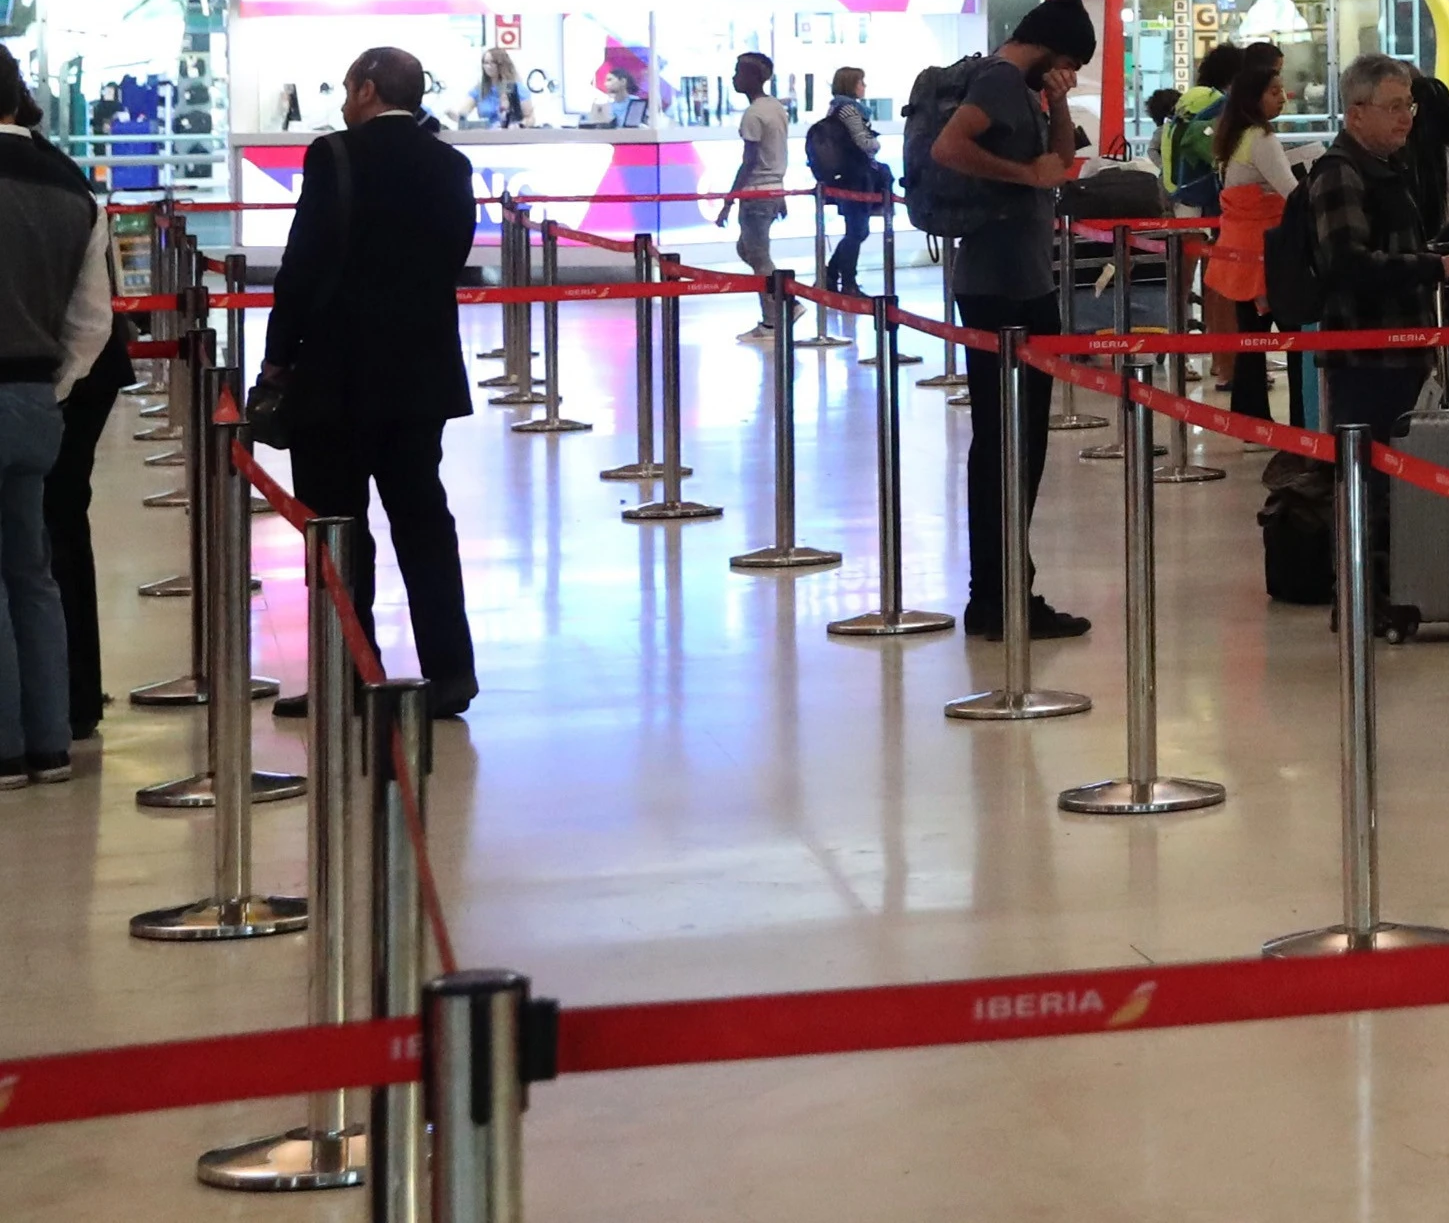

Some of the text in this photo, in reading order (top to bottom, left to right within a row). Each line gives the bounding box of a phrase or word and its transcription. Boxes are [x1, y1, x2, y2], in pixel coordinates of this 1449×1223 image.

[1240, 337, 1279, 347] IBERIA
[1388, 333, 1426, 343] IBERIA
[1089, 339, 1129, 350] IBERIA
[973, 989, 1104, 1021] IBERIA
